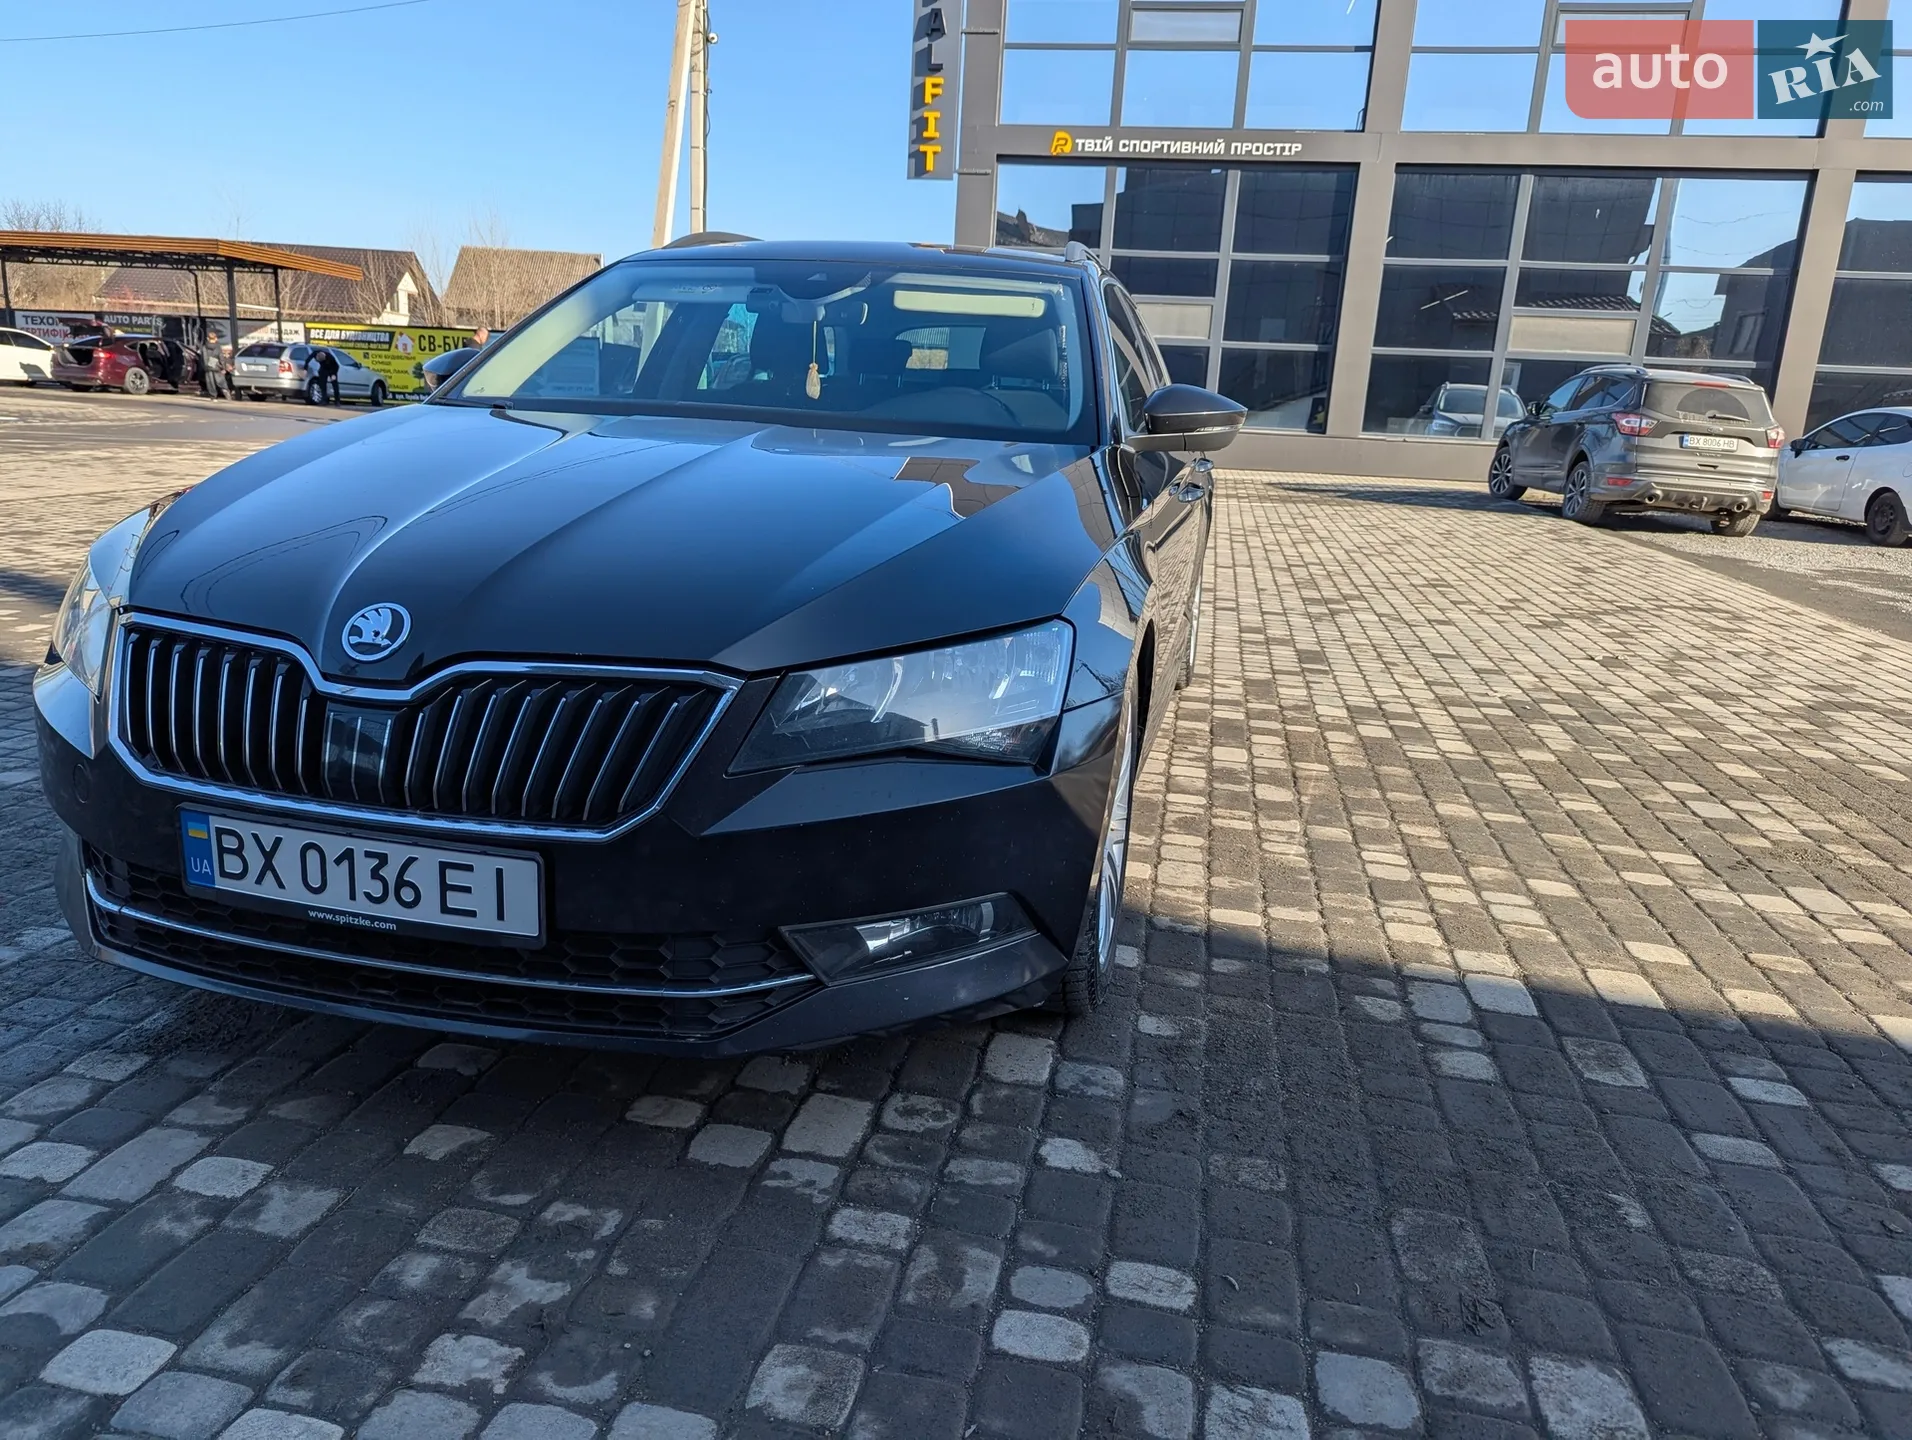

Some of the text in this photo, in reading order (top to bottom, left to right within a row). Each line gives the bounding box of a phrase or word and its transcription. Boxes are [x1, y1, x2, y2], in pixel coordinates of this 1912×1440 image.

[919, 77, 944, 172] FIT
[1075, 136, 1303, 156] ТВІЙ СПОРТИВНИЙ ПРОСТІР
[104, 314, 164, 327] AUTO PARTS
[270, 327, 300, 336] прдаж
[310, 328, 390, 342] ВСЕ ДЛЯ БУДІВНИЦТВА
[1689, 436, 1735, 449] BX 8006 HB
[190, 856, 212, 876] UA
[214, 825, 505, 922] BX 0136 EI
[308, 907, 397, 931] www.spitzke.com
